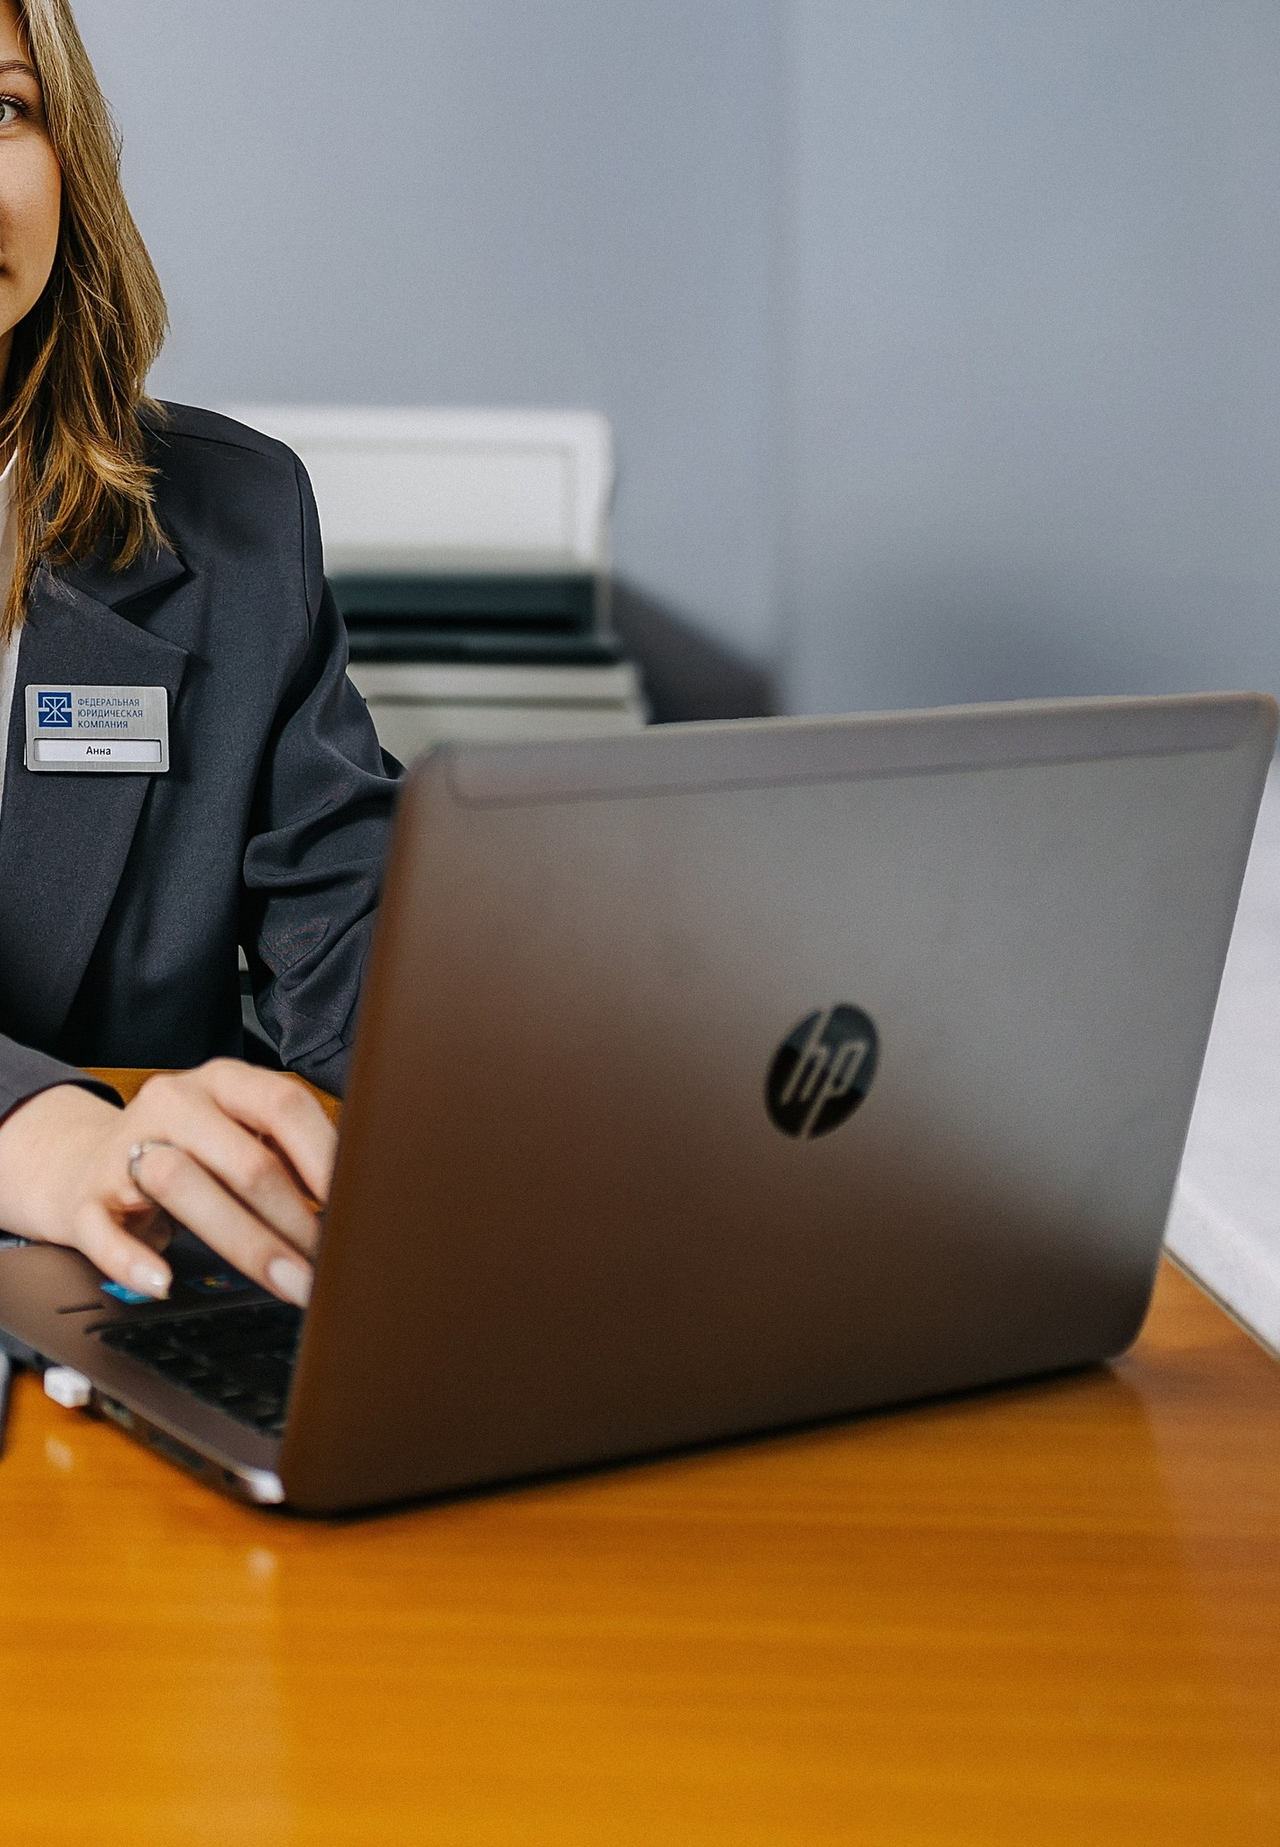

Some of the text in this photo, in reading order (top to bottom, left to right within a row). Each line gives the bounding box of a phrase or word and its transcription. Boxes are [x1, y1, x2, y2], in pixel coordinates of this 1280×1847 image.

[77, 697, 140, 708] ФЕДЕРАЛЬНАЯ
[77, 709, 143, 719] ЮРИДИЧЕСКАЯ
[77, 720, 129, 729] КОМПАНИЯ
[86, 746, 111, 756] Анна
[780, 1006, 869, 1137] hp
